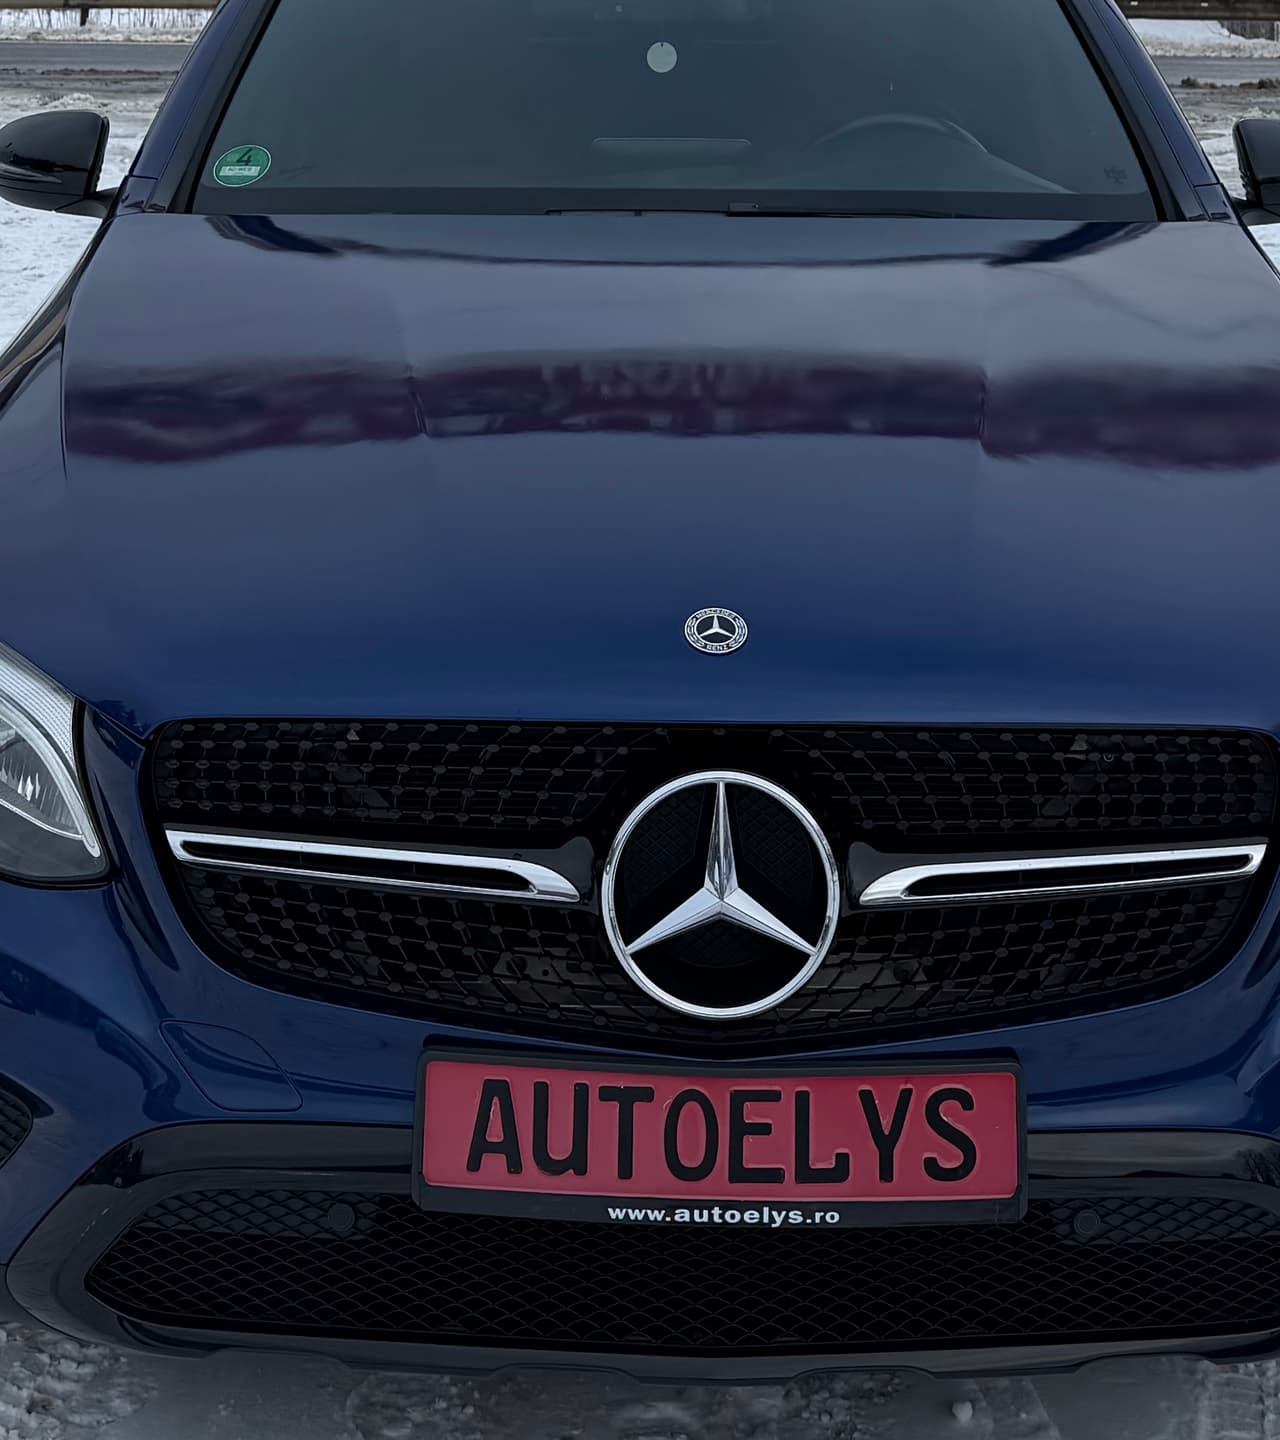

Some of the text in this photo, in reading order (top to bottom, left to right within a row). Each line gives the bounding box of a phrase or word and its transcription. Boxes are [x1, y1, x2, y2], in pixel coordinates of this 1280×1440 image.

[235, 147, 253, 167] 4
[465, 1078, 978, 1185] AUTOELYS
[607, 1204, 841, 1229] www.autoelys.ro
